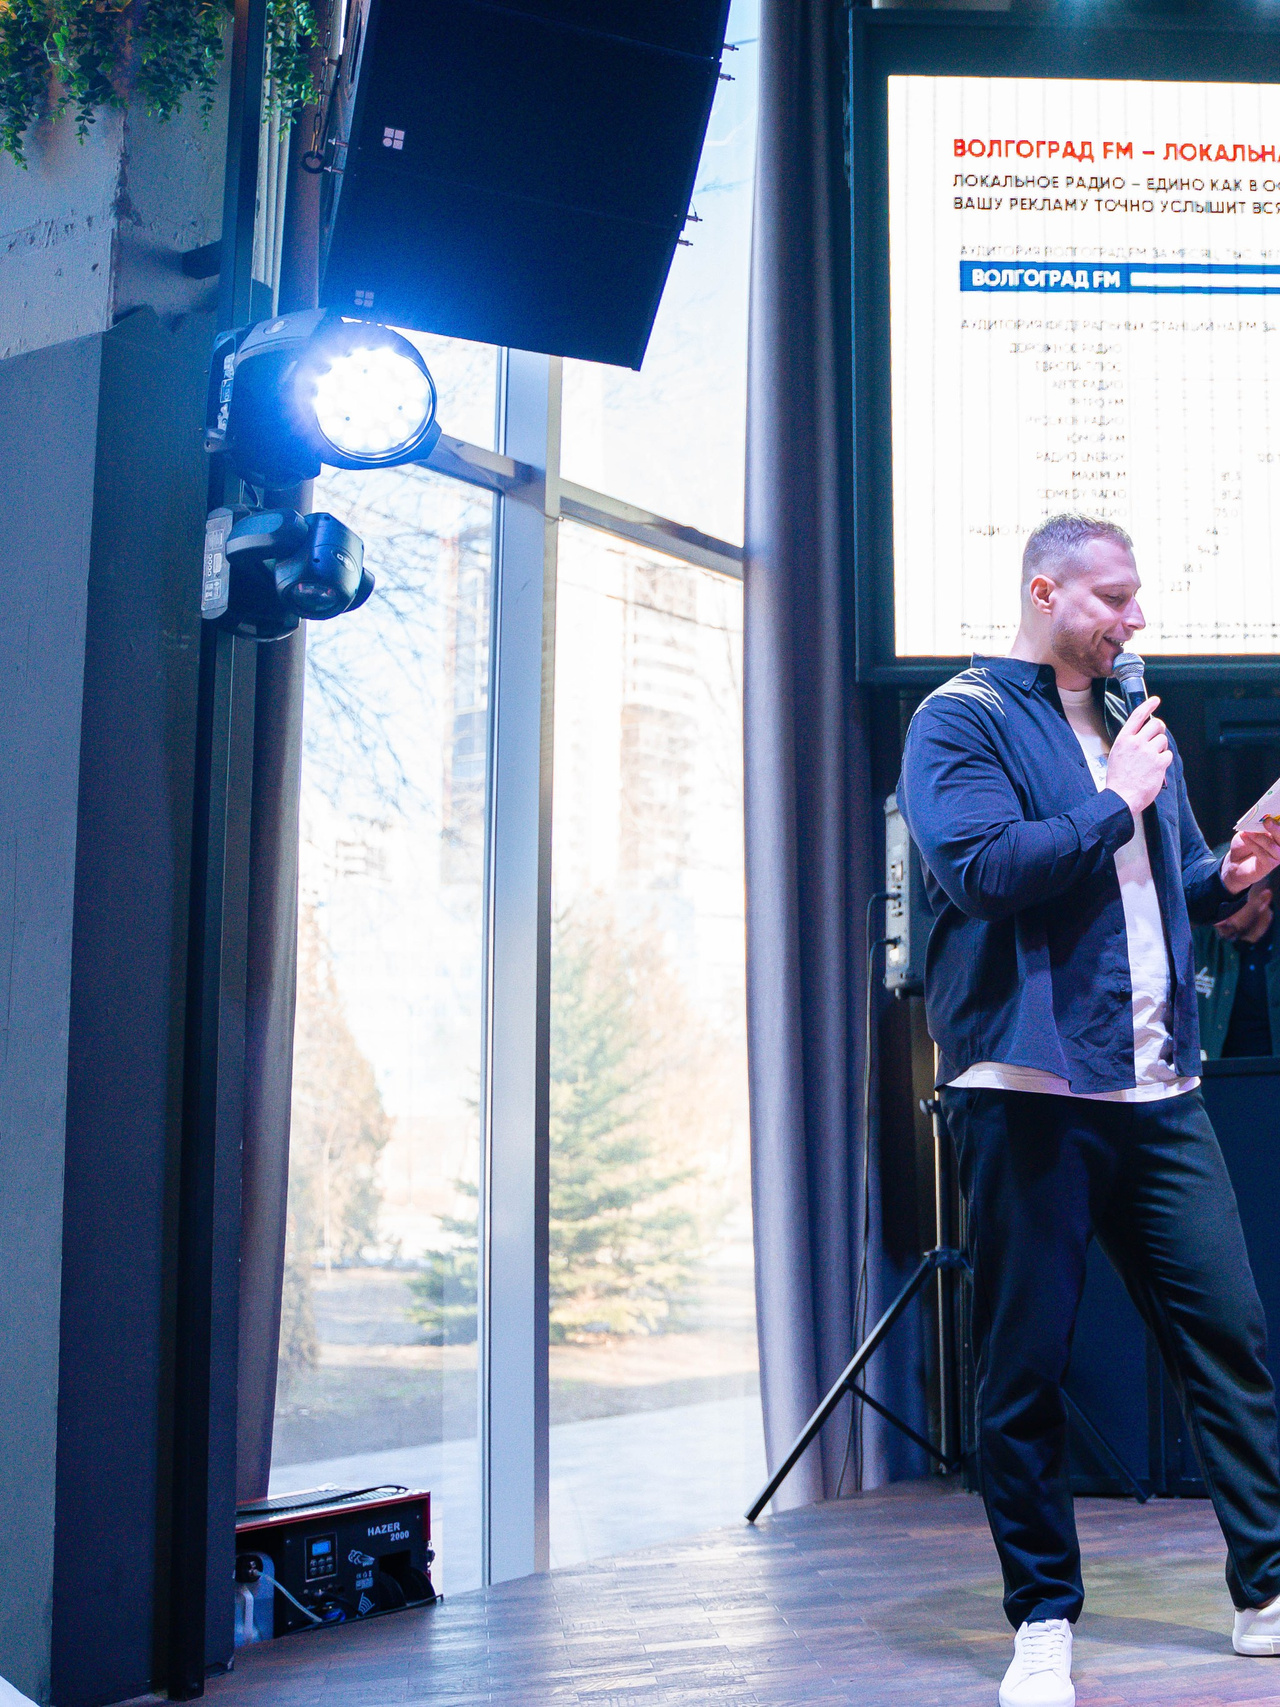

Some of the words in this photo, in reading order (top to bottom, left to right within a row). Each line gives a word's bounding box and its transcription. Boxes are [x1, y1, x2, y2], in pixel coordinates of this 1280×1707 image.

[953, 138, 1095, 163] ВОЛГОГРАД
[1102, 141, 1133, 160] FM
[953, 174, 1059, 189] ЛОКАЛЬНОЕ
[1065, 176, 1126, 192] РАДИО
[1146, 177, 1205, 193] ЕДИНО
[1210, 178, 1243, 192] КАК
[1249, 179, 1258, 192] В
[953, 197, 1003, 210] ВАШУ
[1009, 198, 1089, 212] РЕКЛАМУ
[1094, 199, 1155, 213] ТОЧНО
[1160, 200, 1247, 214] УСЛЫШИТ
[971, 268, 1089, 290] ВОЛГОГРАД
[1092, 270, 1121, 288] FM
[367, 1521, 401, 1537] HAZER
[390, 1529, 410, 1542] 2000
